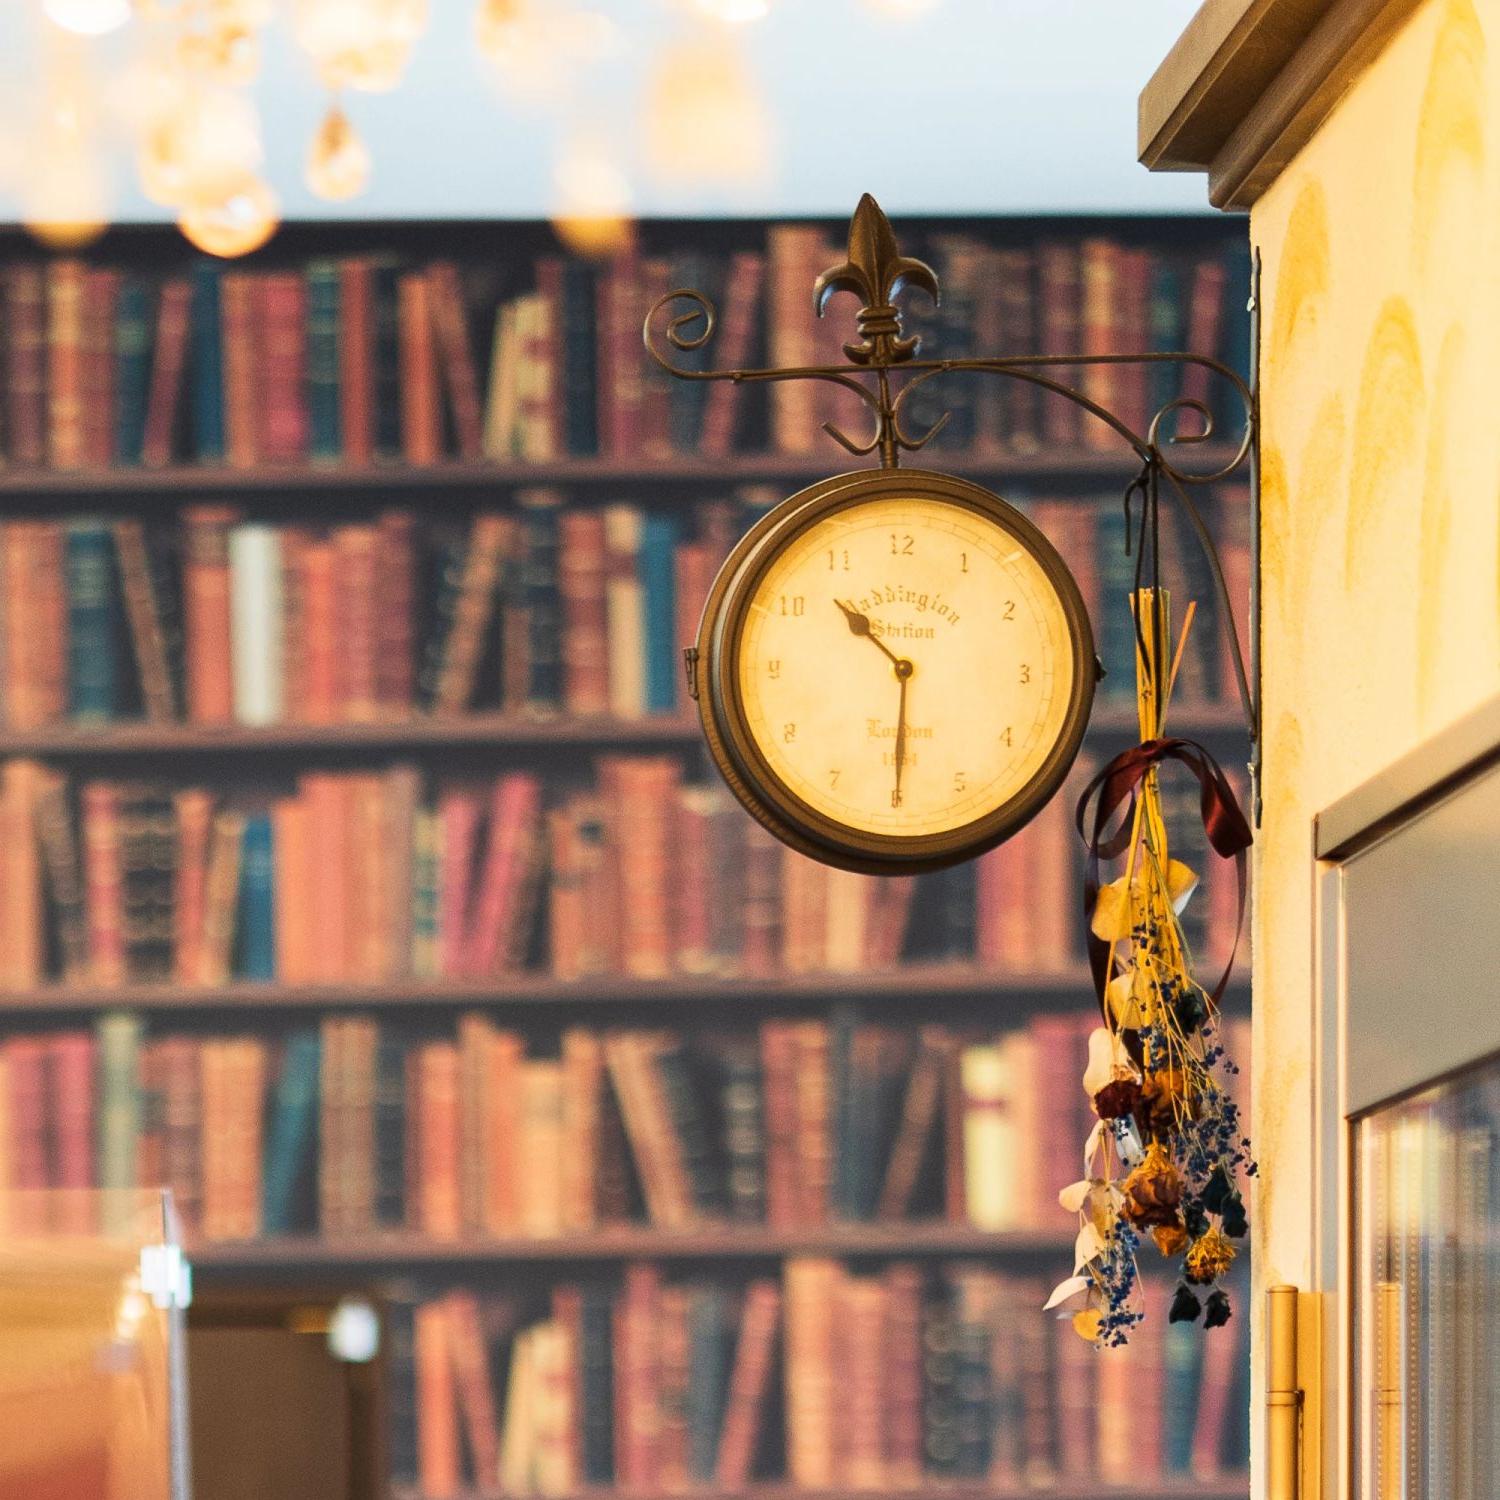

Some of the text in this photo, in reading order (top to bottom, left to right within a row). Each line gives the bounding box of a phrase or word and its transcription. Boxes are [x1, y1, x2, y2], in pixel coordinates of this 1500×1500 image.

[890, 533, 915, 556] 12
[827, 549, 851, 571] 11
[961, 552, 969, 574] 1
[780, 594, 805, 617] 10
[1001, 600, 1016, 621] 2
[870, 618, 935, 639] Station
[767, 659, 781, 680] 9
[1019, 663, 1031, 684] 3
[783, 722, 797, 744] 8
[999, 726, 1012, 748] 4
[828, 769, 842, 791] 7
[953, 771, 966, 793] 5
